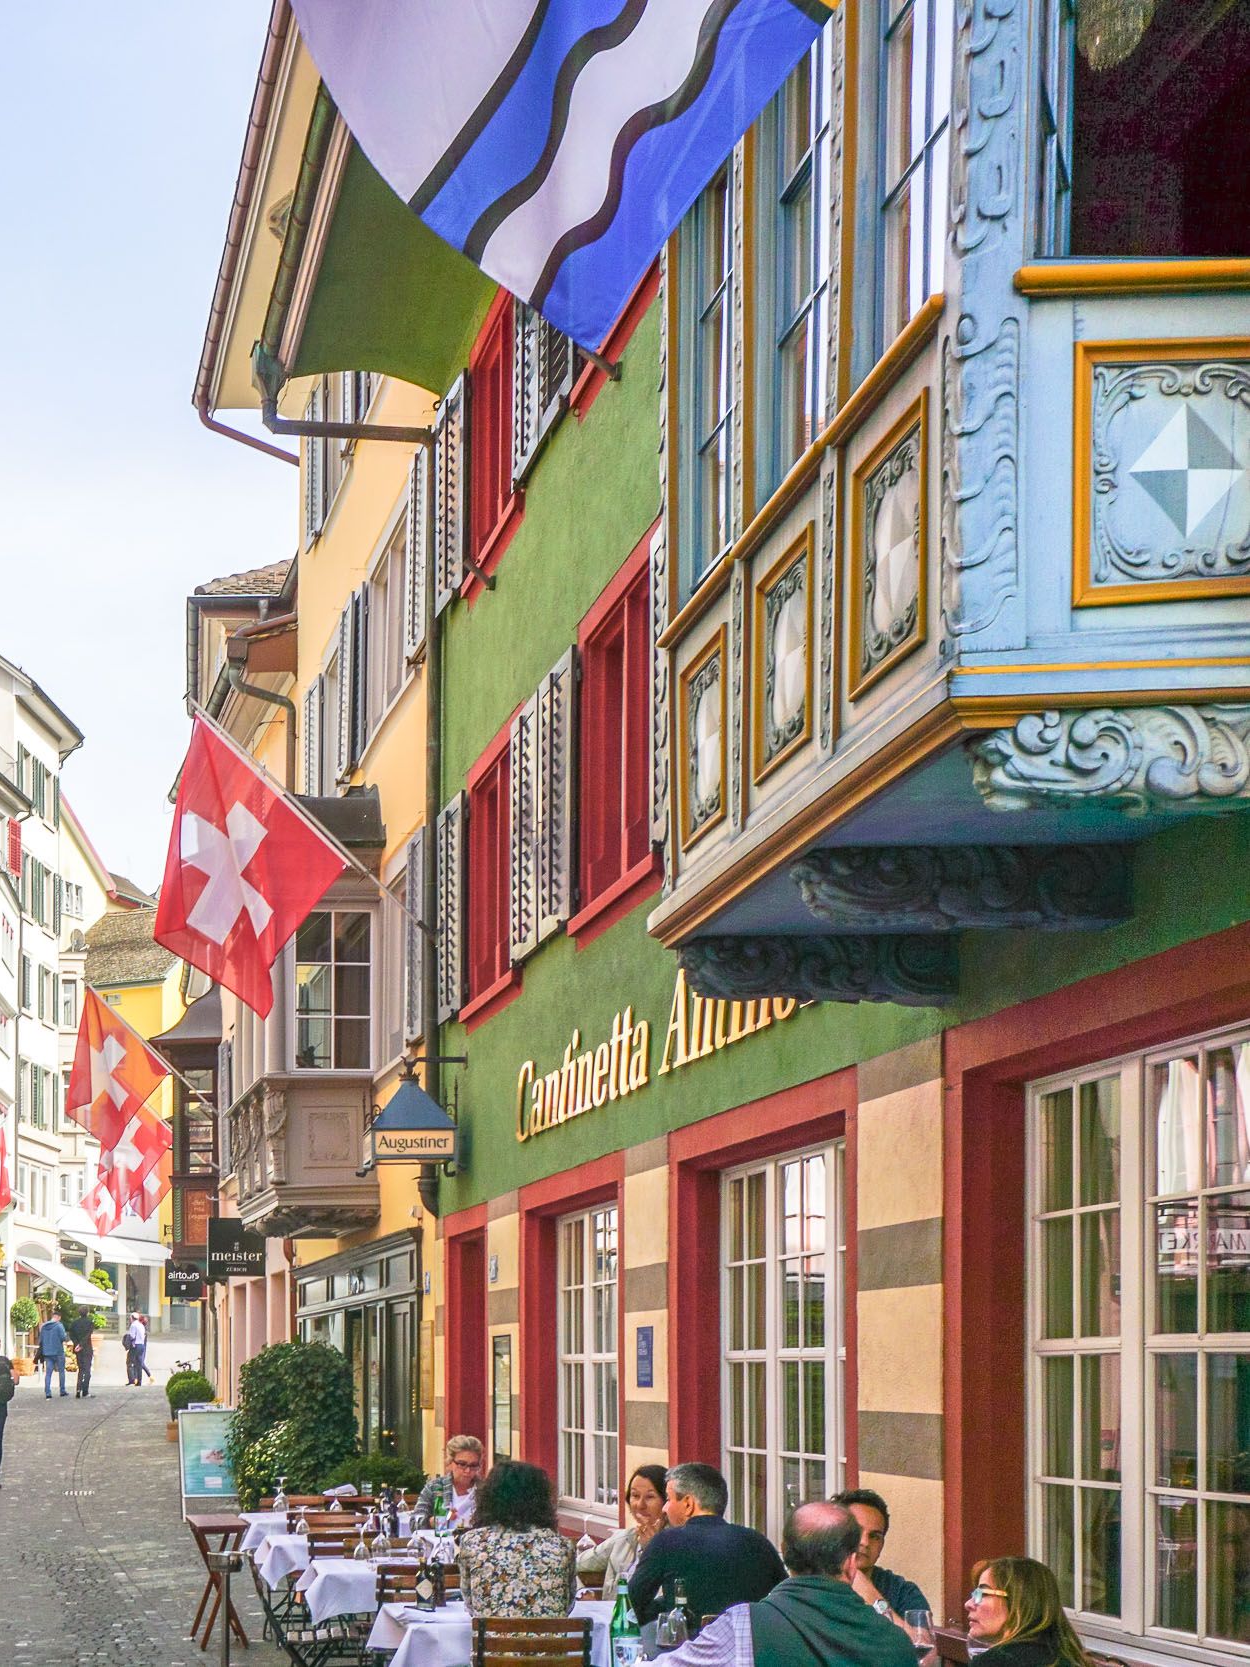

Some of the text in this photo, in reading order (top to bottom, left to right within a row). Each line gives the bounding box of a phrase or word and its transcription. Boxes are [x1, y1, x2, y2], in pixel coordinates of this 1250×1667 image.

[516, 1005, 649, 1143] Cantinetta
[378, 1135, 450, 1153] Augustiner
[211, 1251, 263, 1261] meister
